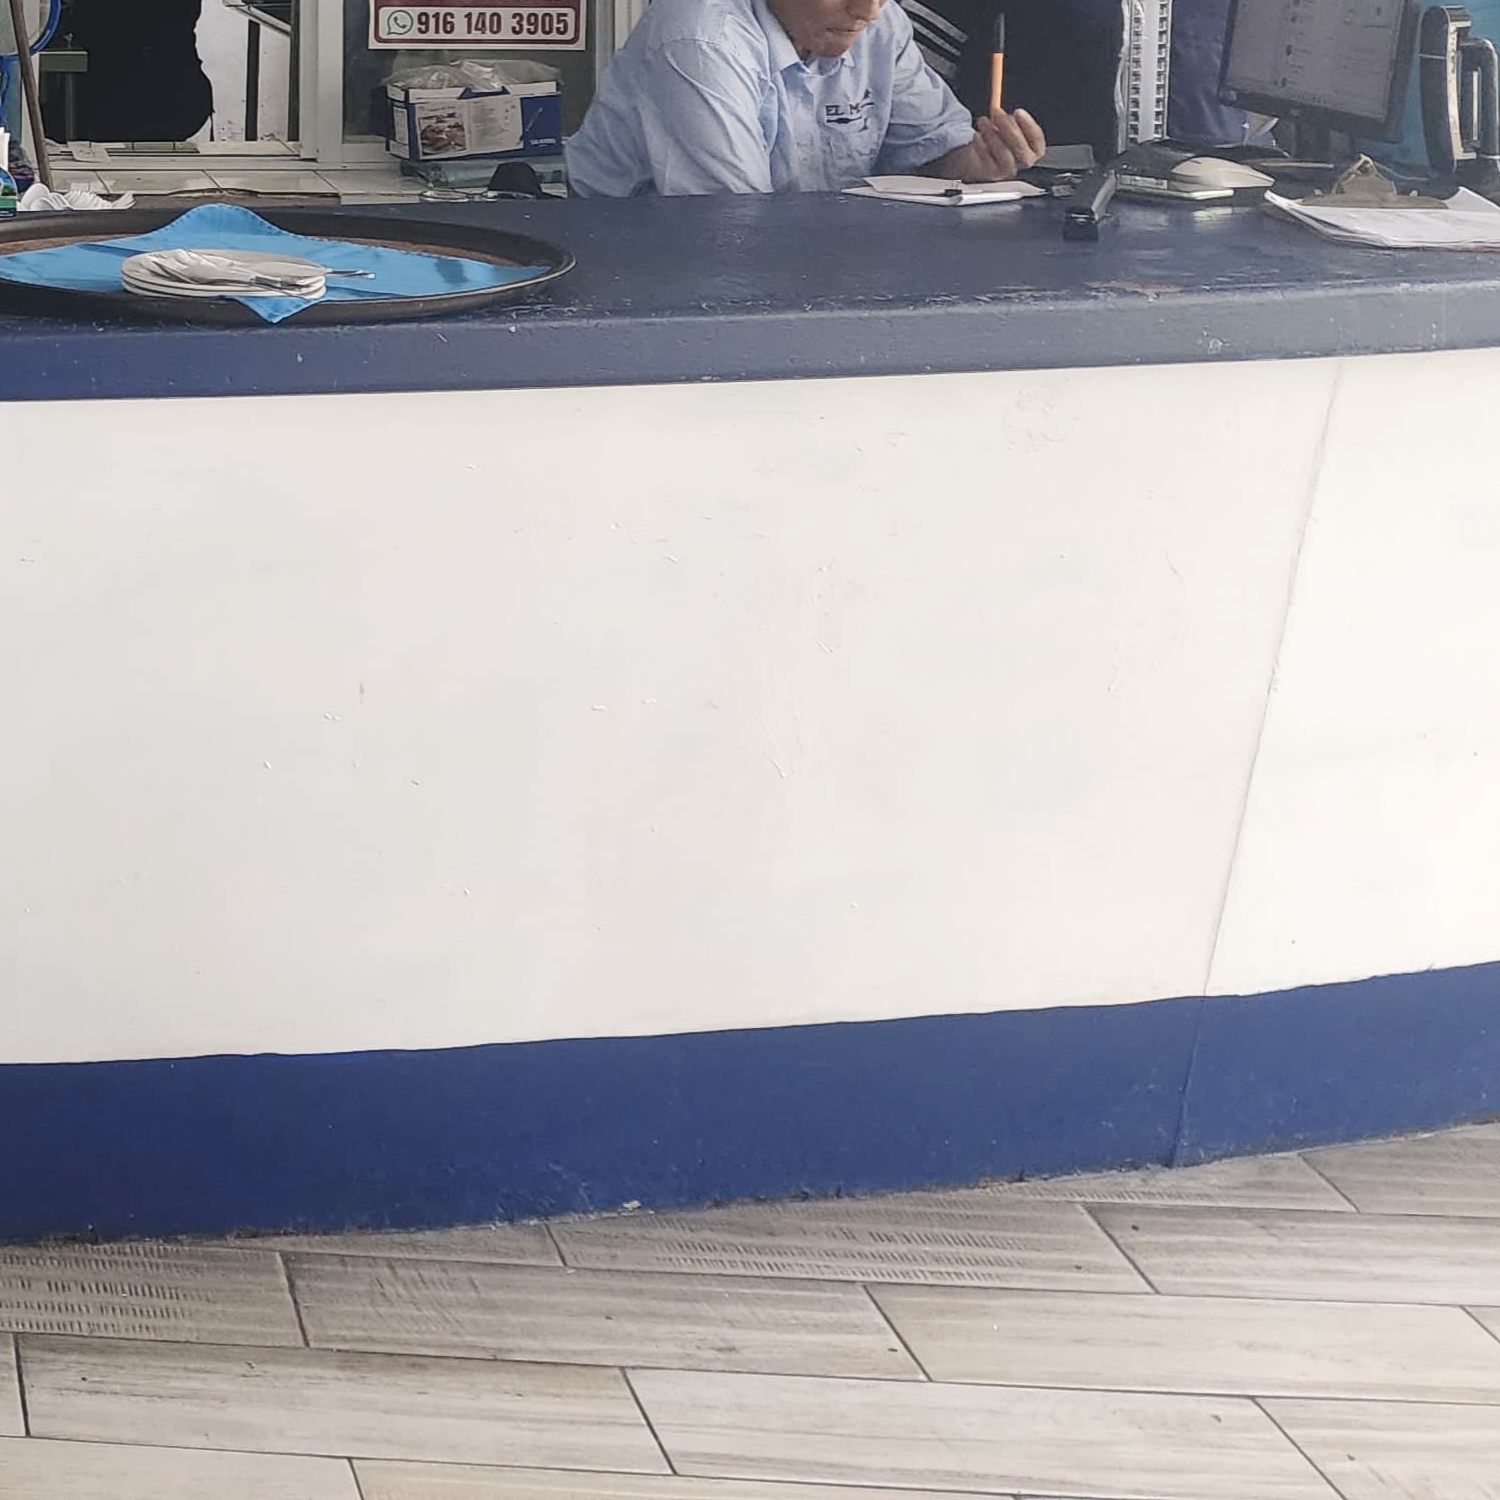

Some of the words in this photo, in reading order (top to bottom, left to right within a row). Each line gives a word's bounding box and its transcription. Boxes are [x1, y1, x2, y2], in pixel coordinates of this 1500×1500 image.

[417, 12, 455, 35] 916
[464, 12, 501, 35] 140
[511, 12, 569, 35] 3905
[825, 105, 844, 116] EL
